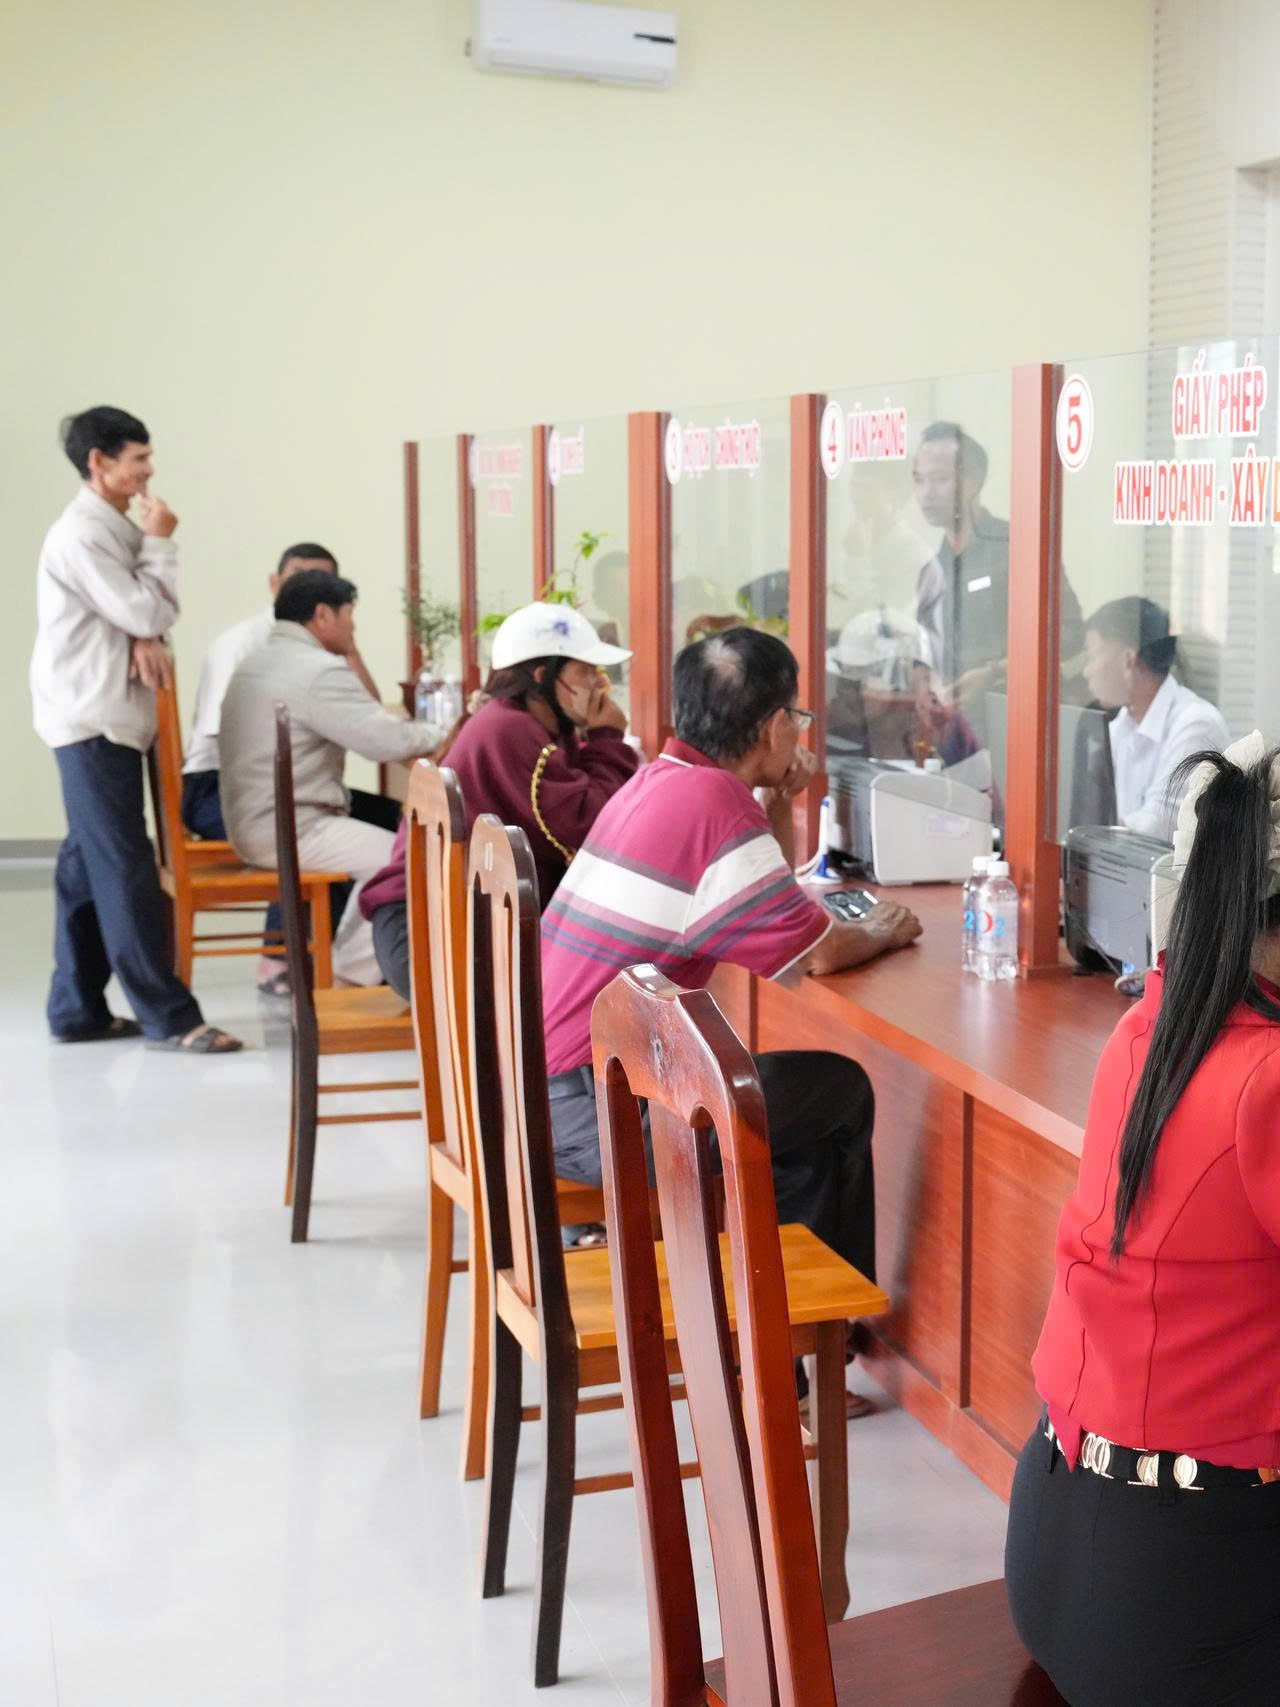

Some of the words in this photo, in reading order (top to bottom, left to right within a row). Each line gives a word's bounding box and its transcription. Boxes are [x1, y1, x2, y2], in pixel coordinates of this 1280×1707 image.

[1066, 393, 1083, 456] 5
[1217, 356, 1265, 434] PHÉP
[827, 417, 837, 462] 4
[1114, 463, 1152, 522] KINH
[1156, 463, 1214, 523] DOANH
[1231, 446, 1268, 524] XÂY
